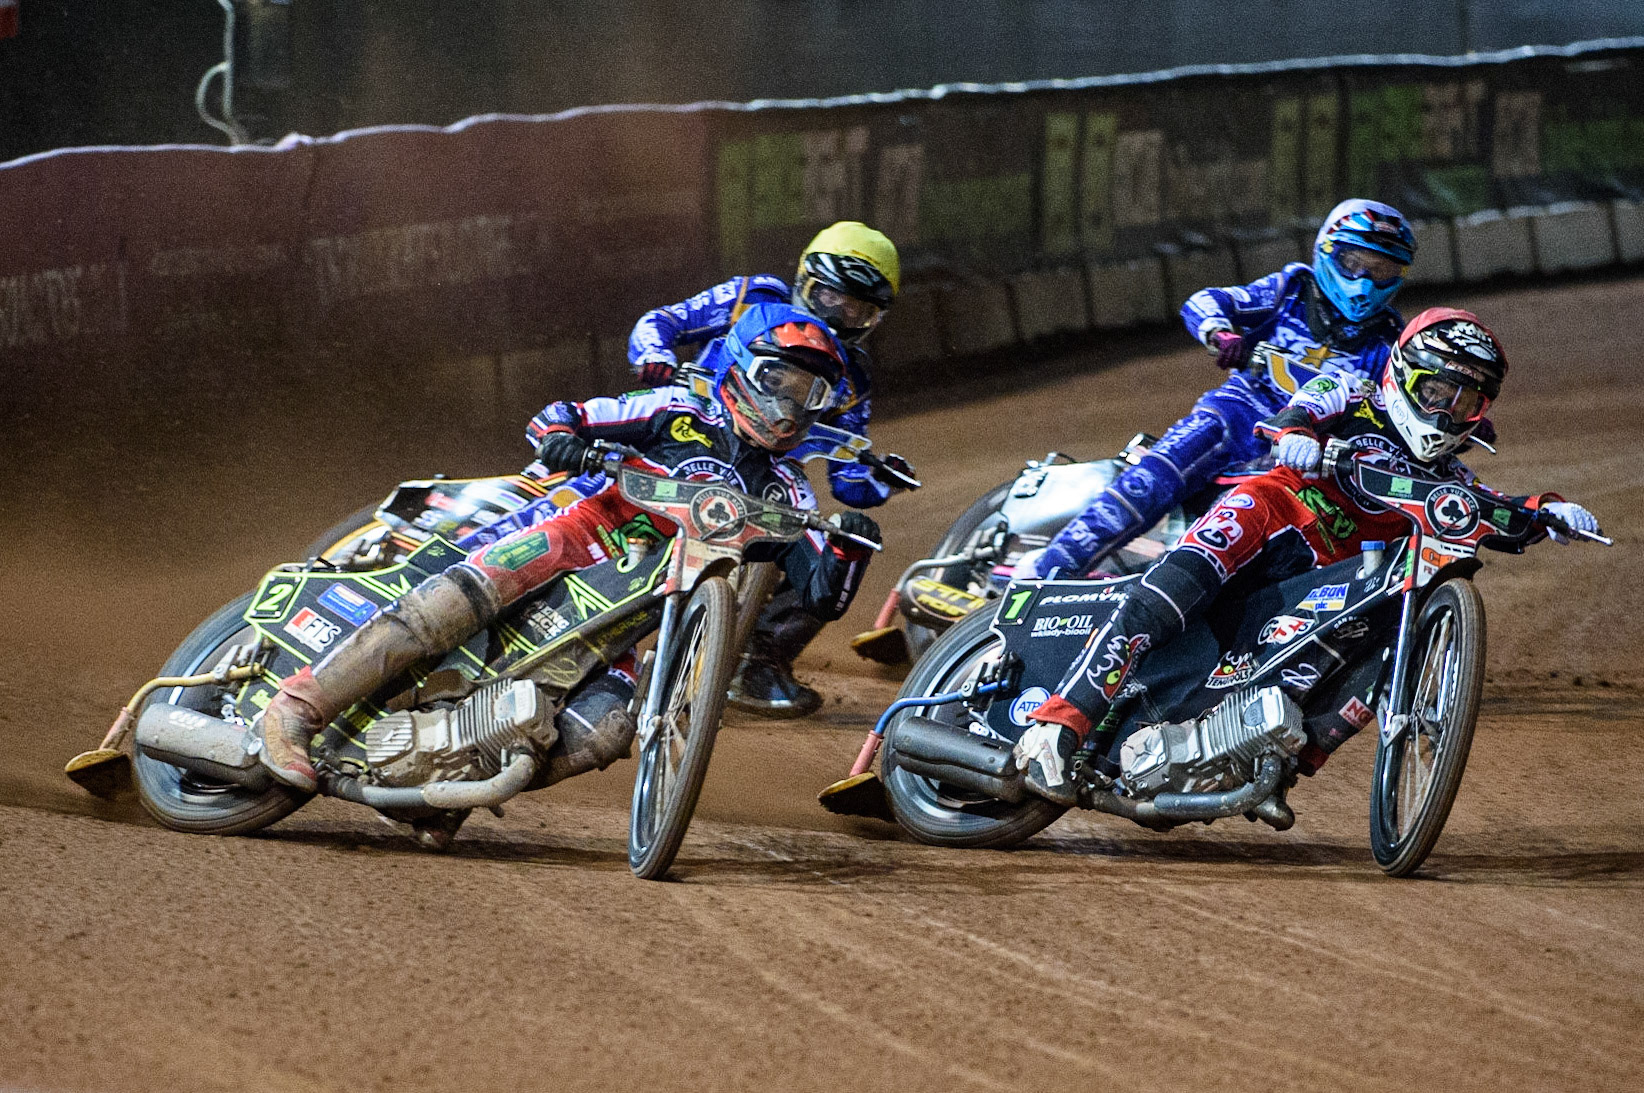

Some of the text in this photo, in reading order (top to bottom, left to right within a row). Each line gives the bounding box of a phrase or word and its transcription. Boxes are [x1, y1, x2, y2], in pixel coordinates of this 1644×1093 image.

[1430, 489, 1447, 502] BELLE
[1450, 488, 1464, 497] VUE
[256, 583, 293, 611] 2
[1004, 590, 1032, 619] 1
